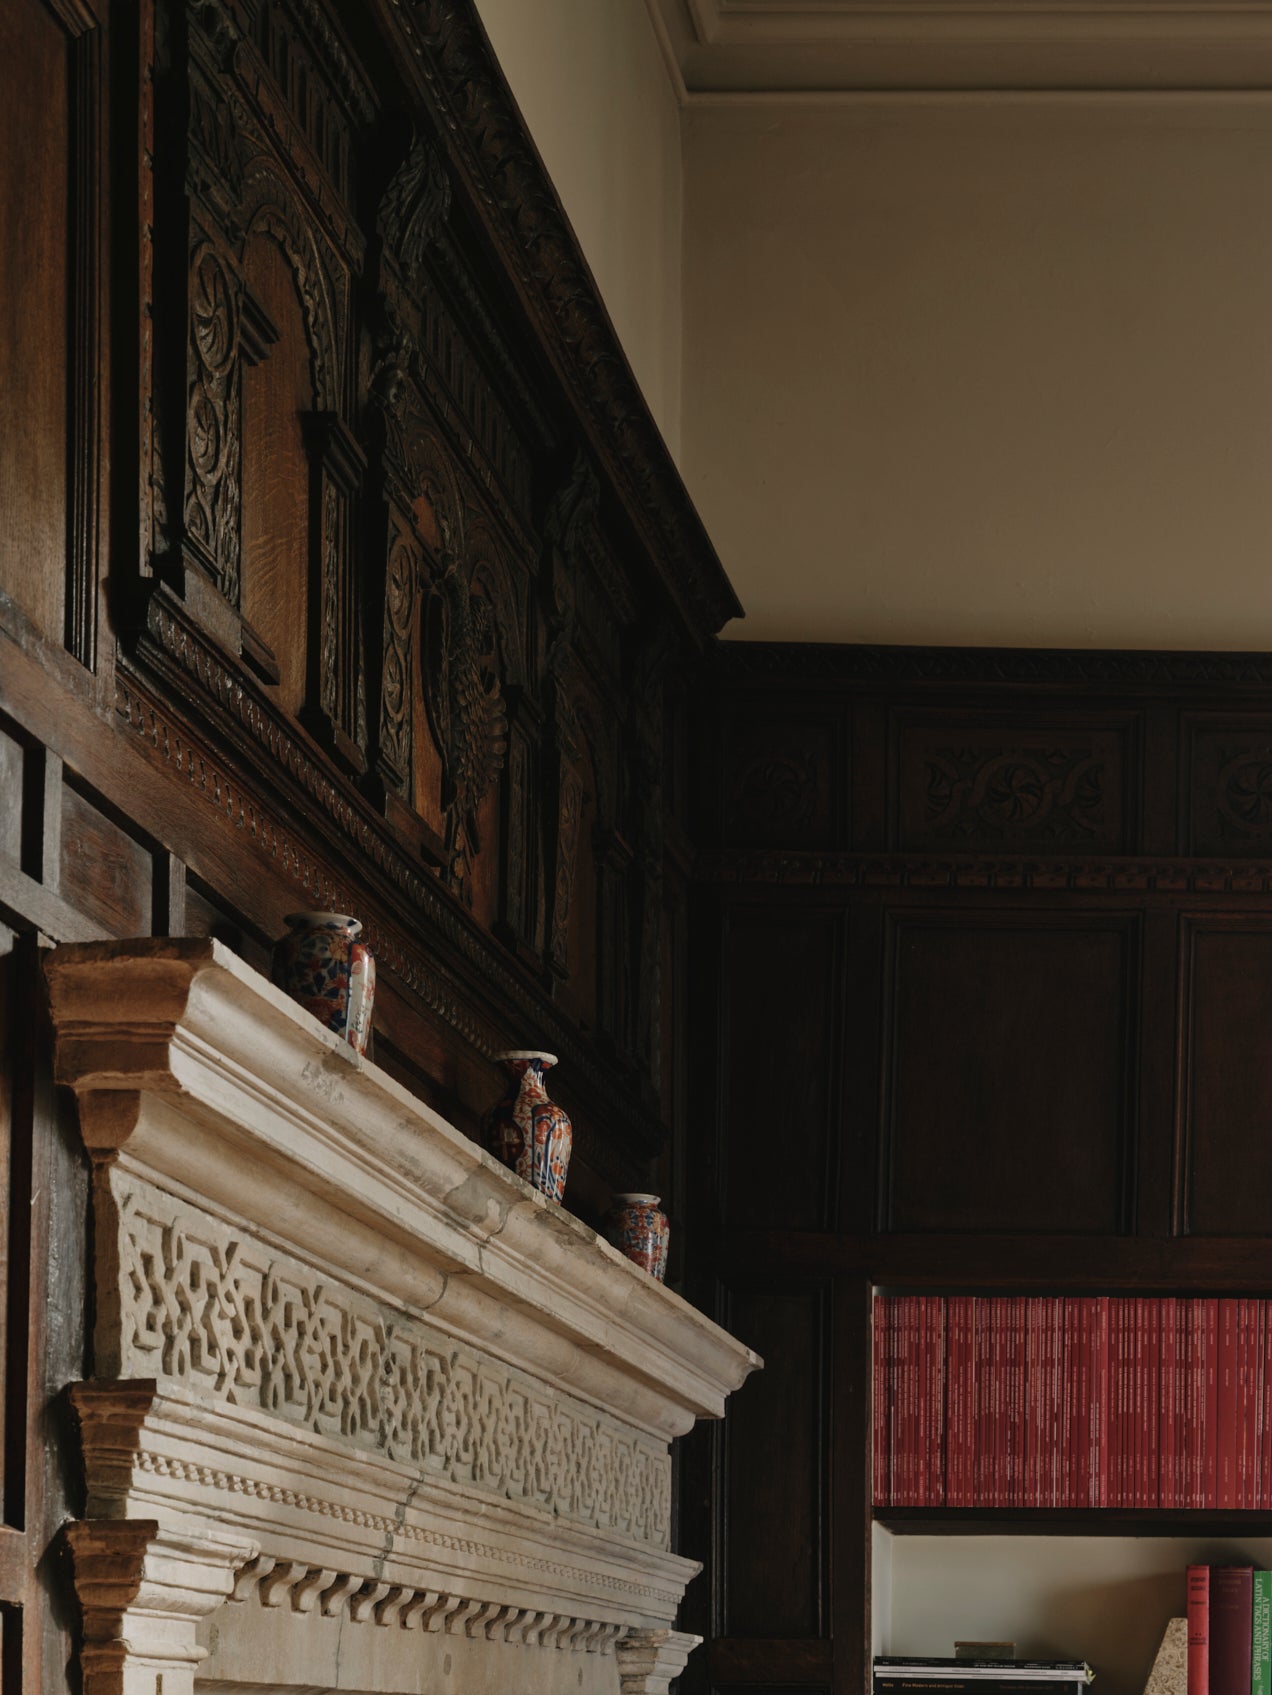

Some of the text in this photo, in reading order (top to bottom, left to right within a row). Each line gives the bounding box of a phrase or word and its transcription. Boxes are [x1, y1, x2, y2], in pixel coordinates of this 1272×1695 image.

[1253, 1578, 1263, 1681] LATIN TAGS AND PHRASES
[1262, 1604, 1270, 1651] DICTIONARY
[1261, 1651, 1269, 1662] OF
